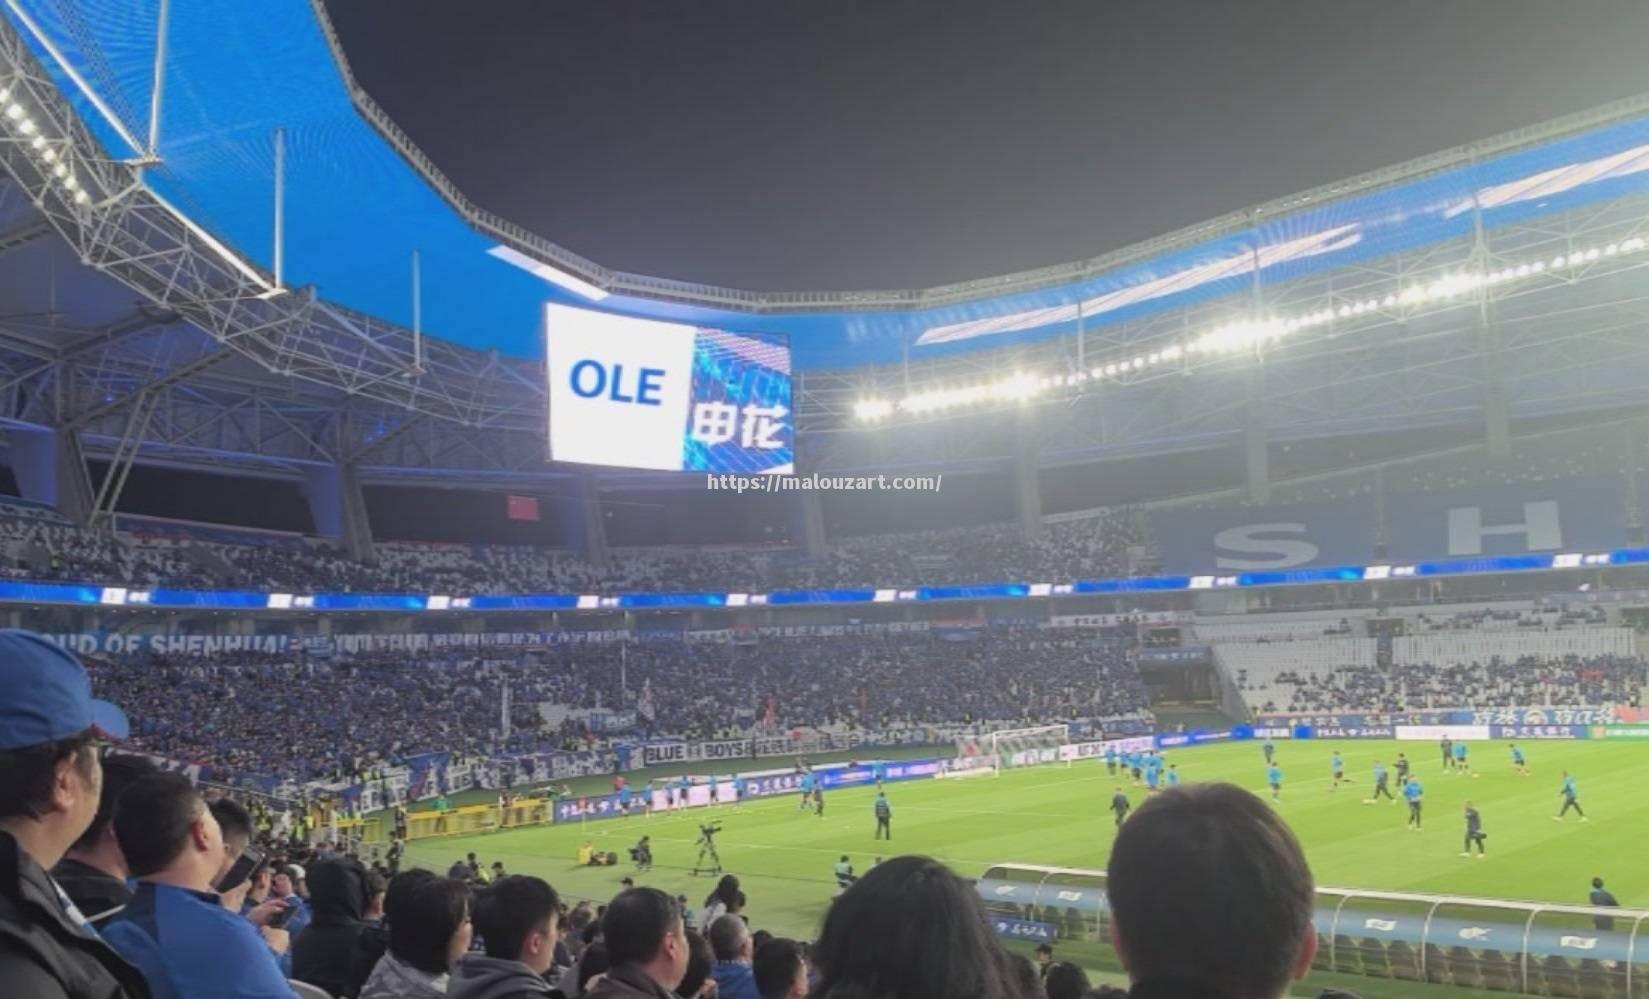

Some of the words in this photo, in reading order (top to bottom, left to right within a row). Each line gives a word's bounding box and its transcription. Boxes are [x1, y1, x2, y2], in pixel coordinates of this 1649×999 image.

[569, 359, 666, 406] OLE
[692, 401, 789, 449] 申花
[104, 633, 142, 655] OF
[647, 744, 685, 762] BLUE
[704, 741, 745, 759] BOYS
